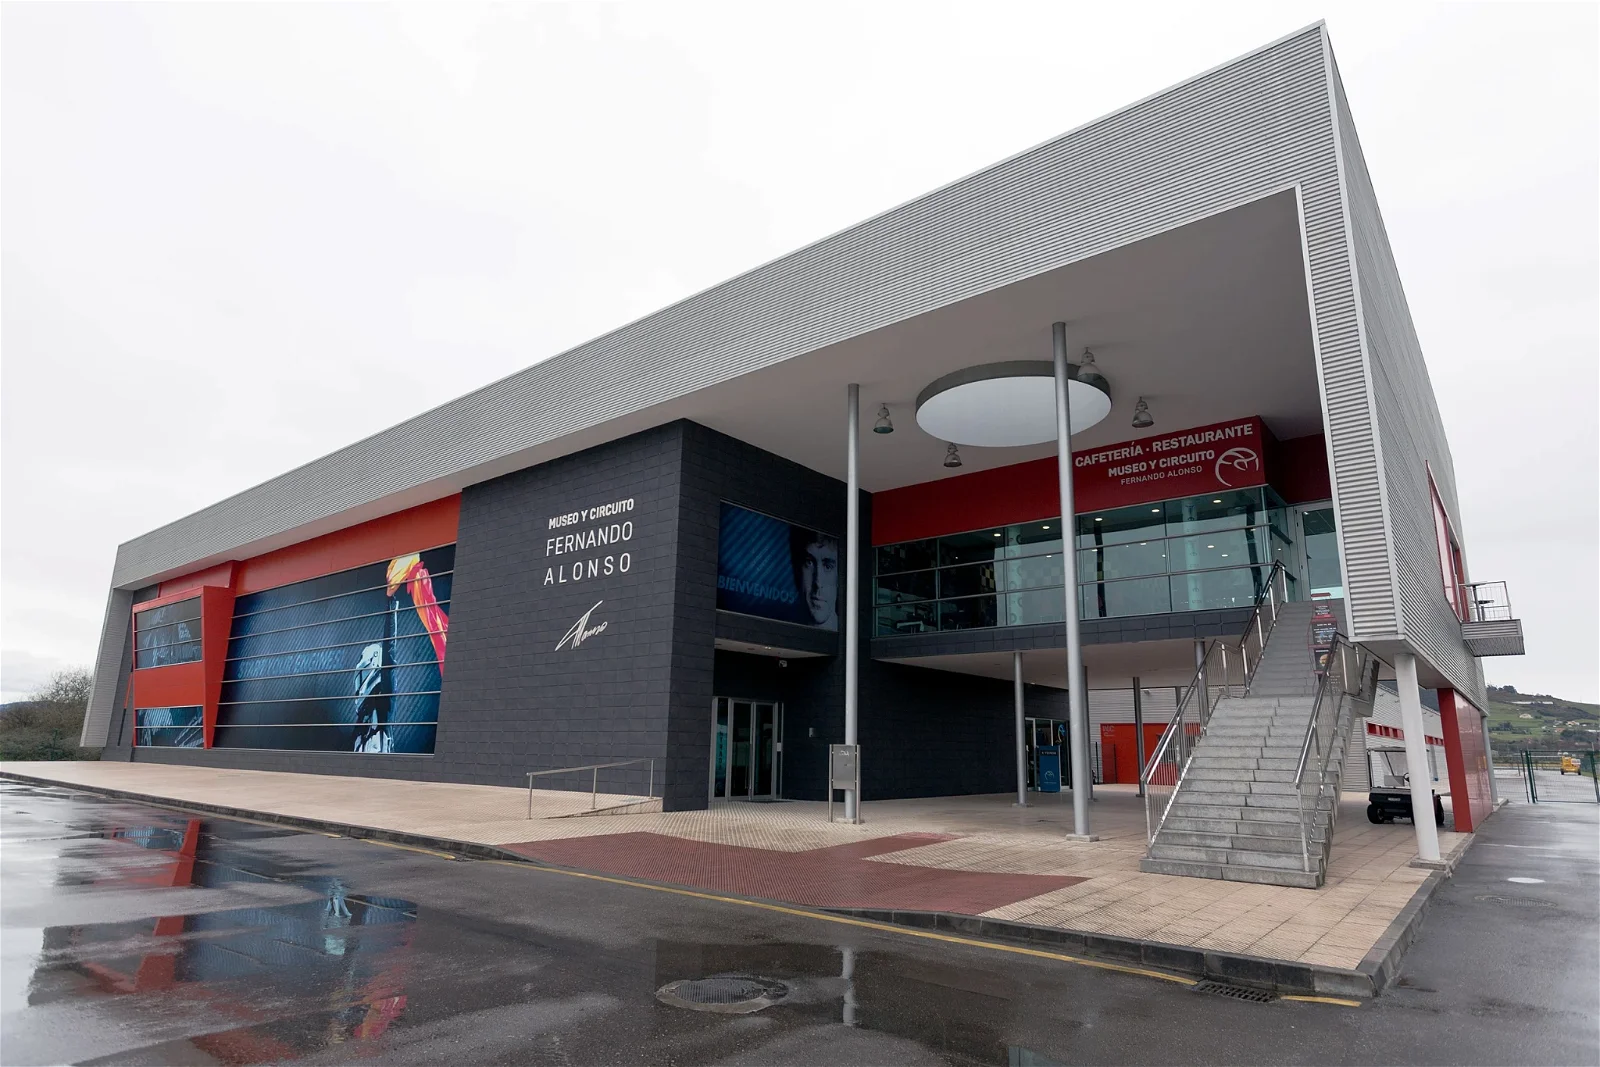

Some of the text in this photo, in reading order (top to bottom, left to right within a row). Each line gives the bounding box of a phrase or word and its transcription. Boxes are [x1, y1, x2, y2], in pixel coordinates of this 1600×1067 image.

[1075, 424, 1253, 467] CAFETERÍA RESTAURANTE
[1109, 450, 1215, 477] MUSEO Y CIRCUITO
[1120, 465, 1203, 485] FERNANDO ALONSO
[548, 498, 634, 530] MUSEO Y CIRCUITO
[546, 521, 633, 556] FERNANDO
[543, 552, 631, 586] ALONSO
[718, 575, 795, 604] BIENVENIDOS
